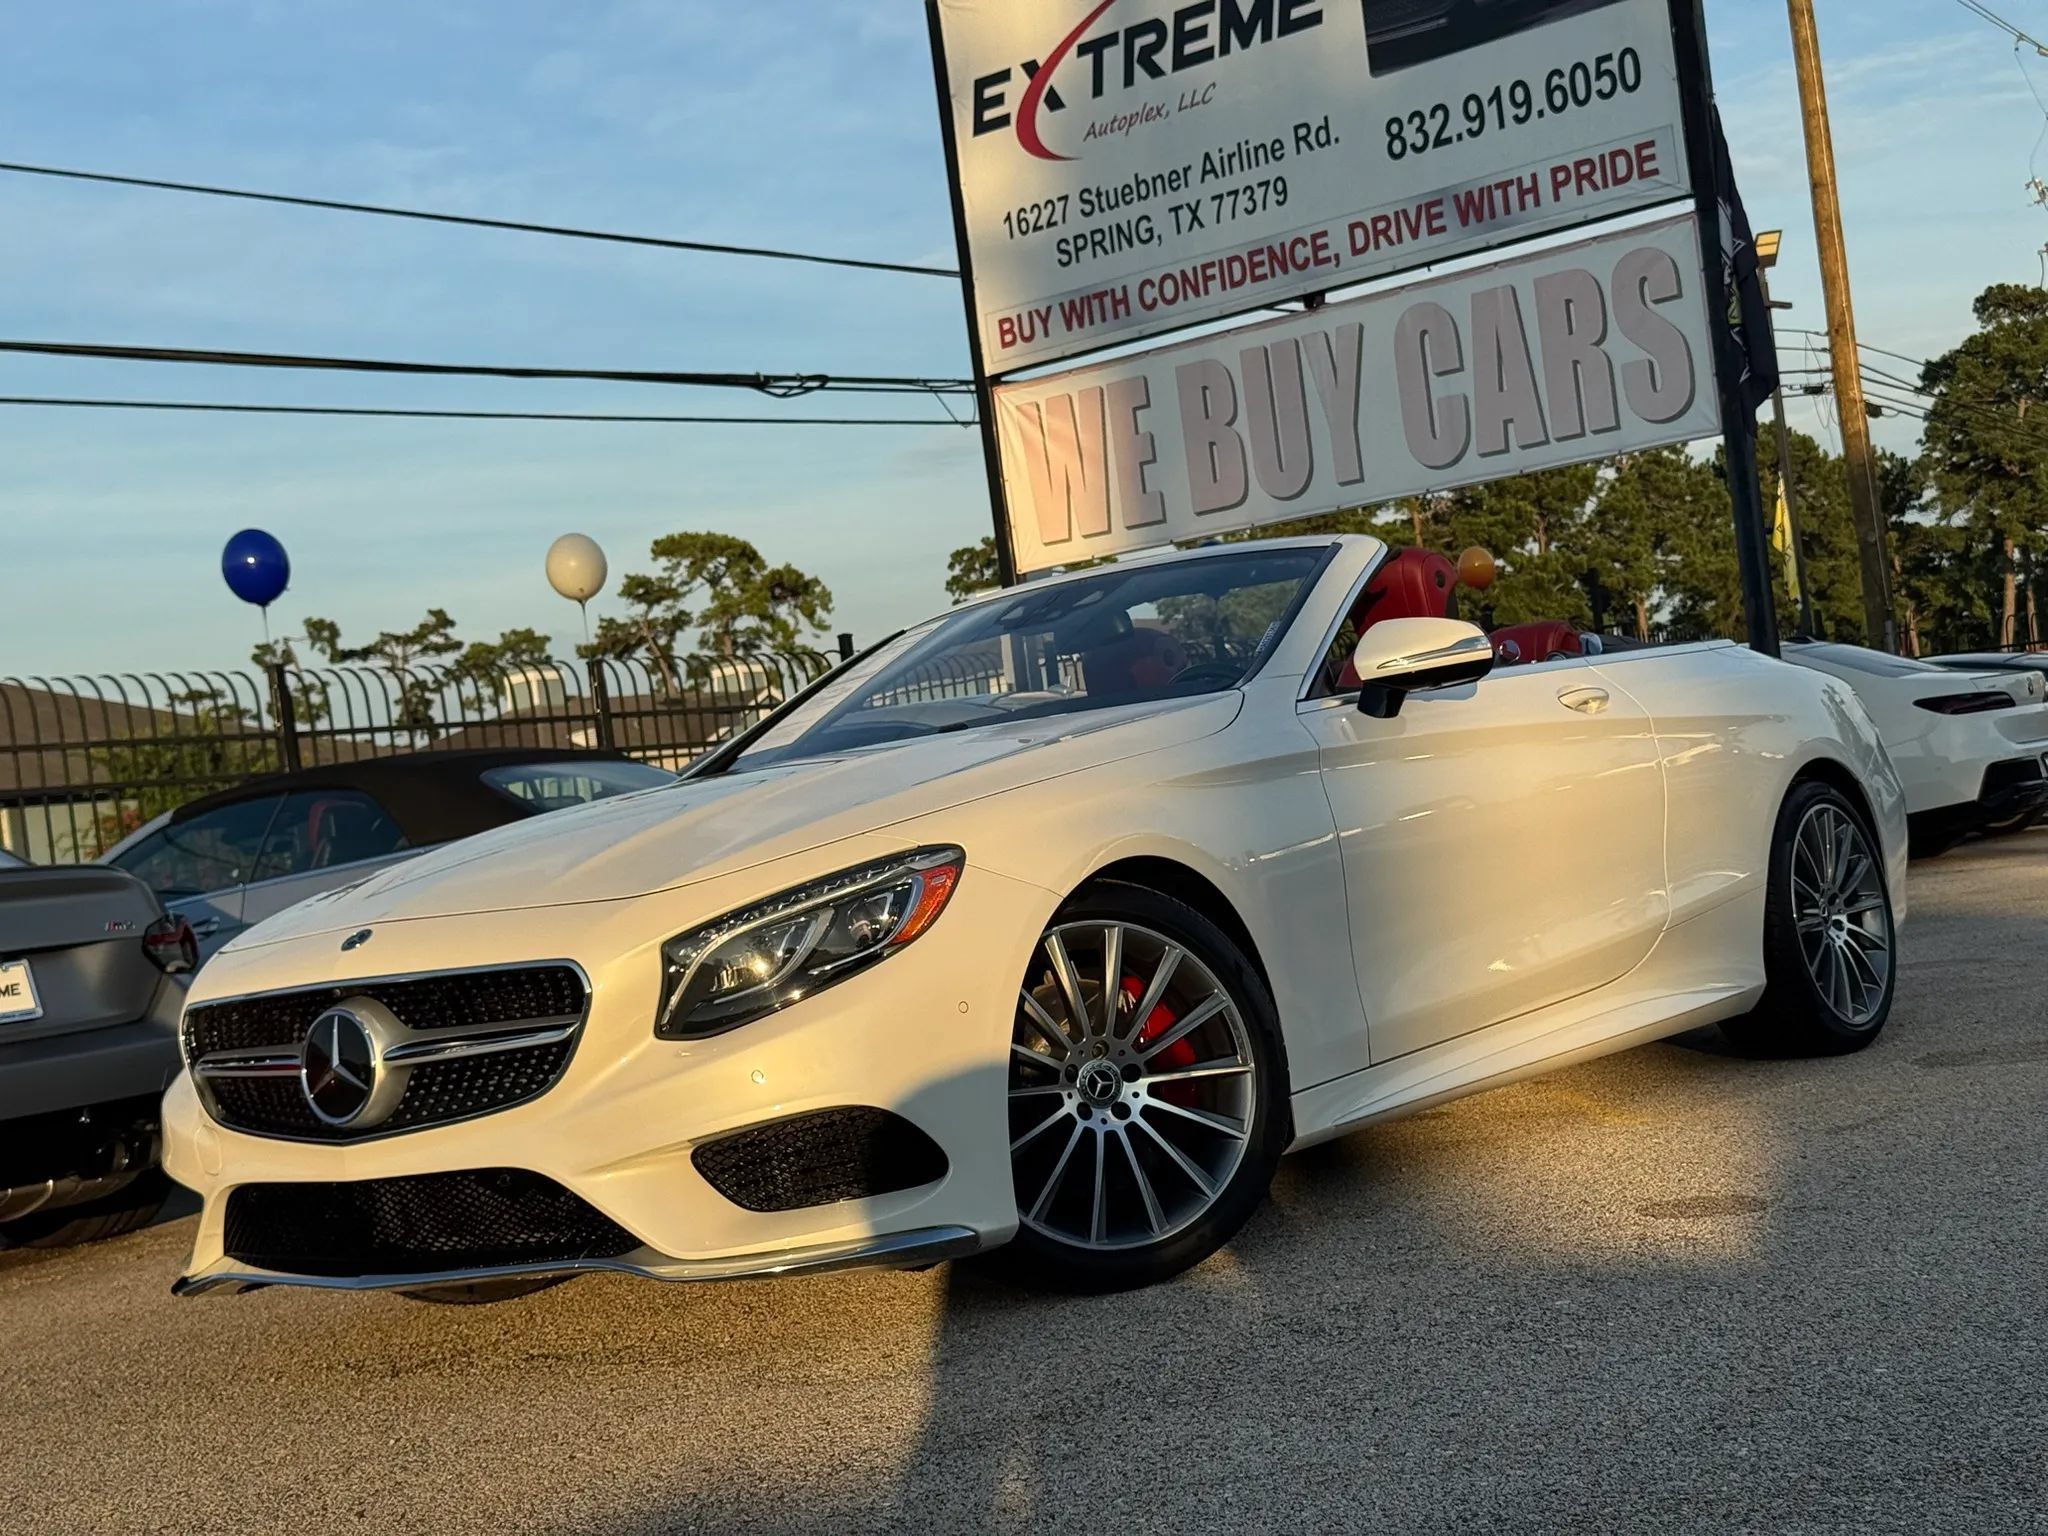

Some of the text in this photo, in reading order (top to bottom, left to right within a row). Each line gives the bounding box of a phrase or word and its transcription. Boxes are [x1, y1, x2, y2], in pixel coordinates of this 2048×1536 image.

[972, 0, 1323, 160] EXTREME
[1082, 83, 1217, 143] Autoplex, LLC
[1384, 46, 1642, 162] 832.919.6050
[1002, 115, 1342, 242] 16227 Stuebner Airline Rd.
[1055, 176, 1289, 268] SPRING, TX 77379
[997, 139, 1661, 351] BUY WITH CONFIDENCE, DRIVE WITH PRIDE
[1016, 373, 1167, 546] WE
[1174, 321, 1364, 516] BUY
[1394, 247, 1696, 469] CARS
